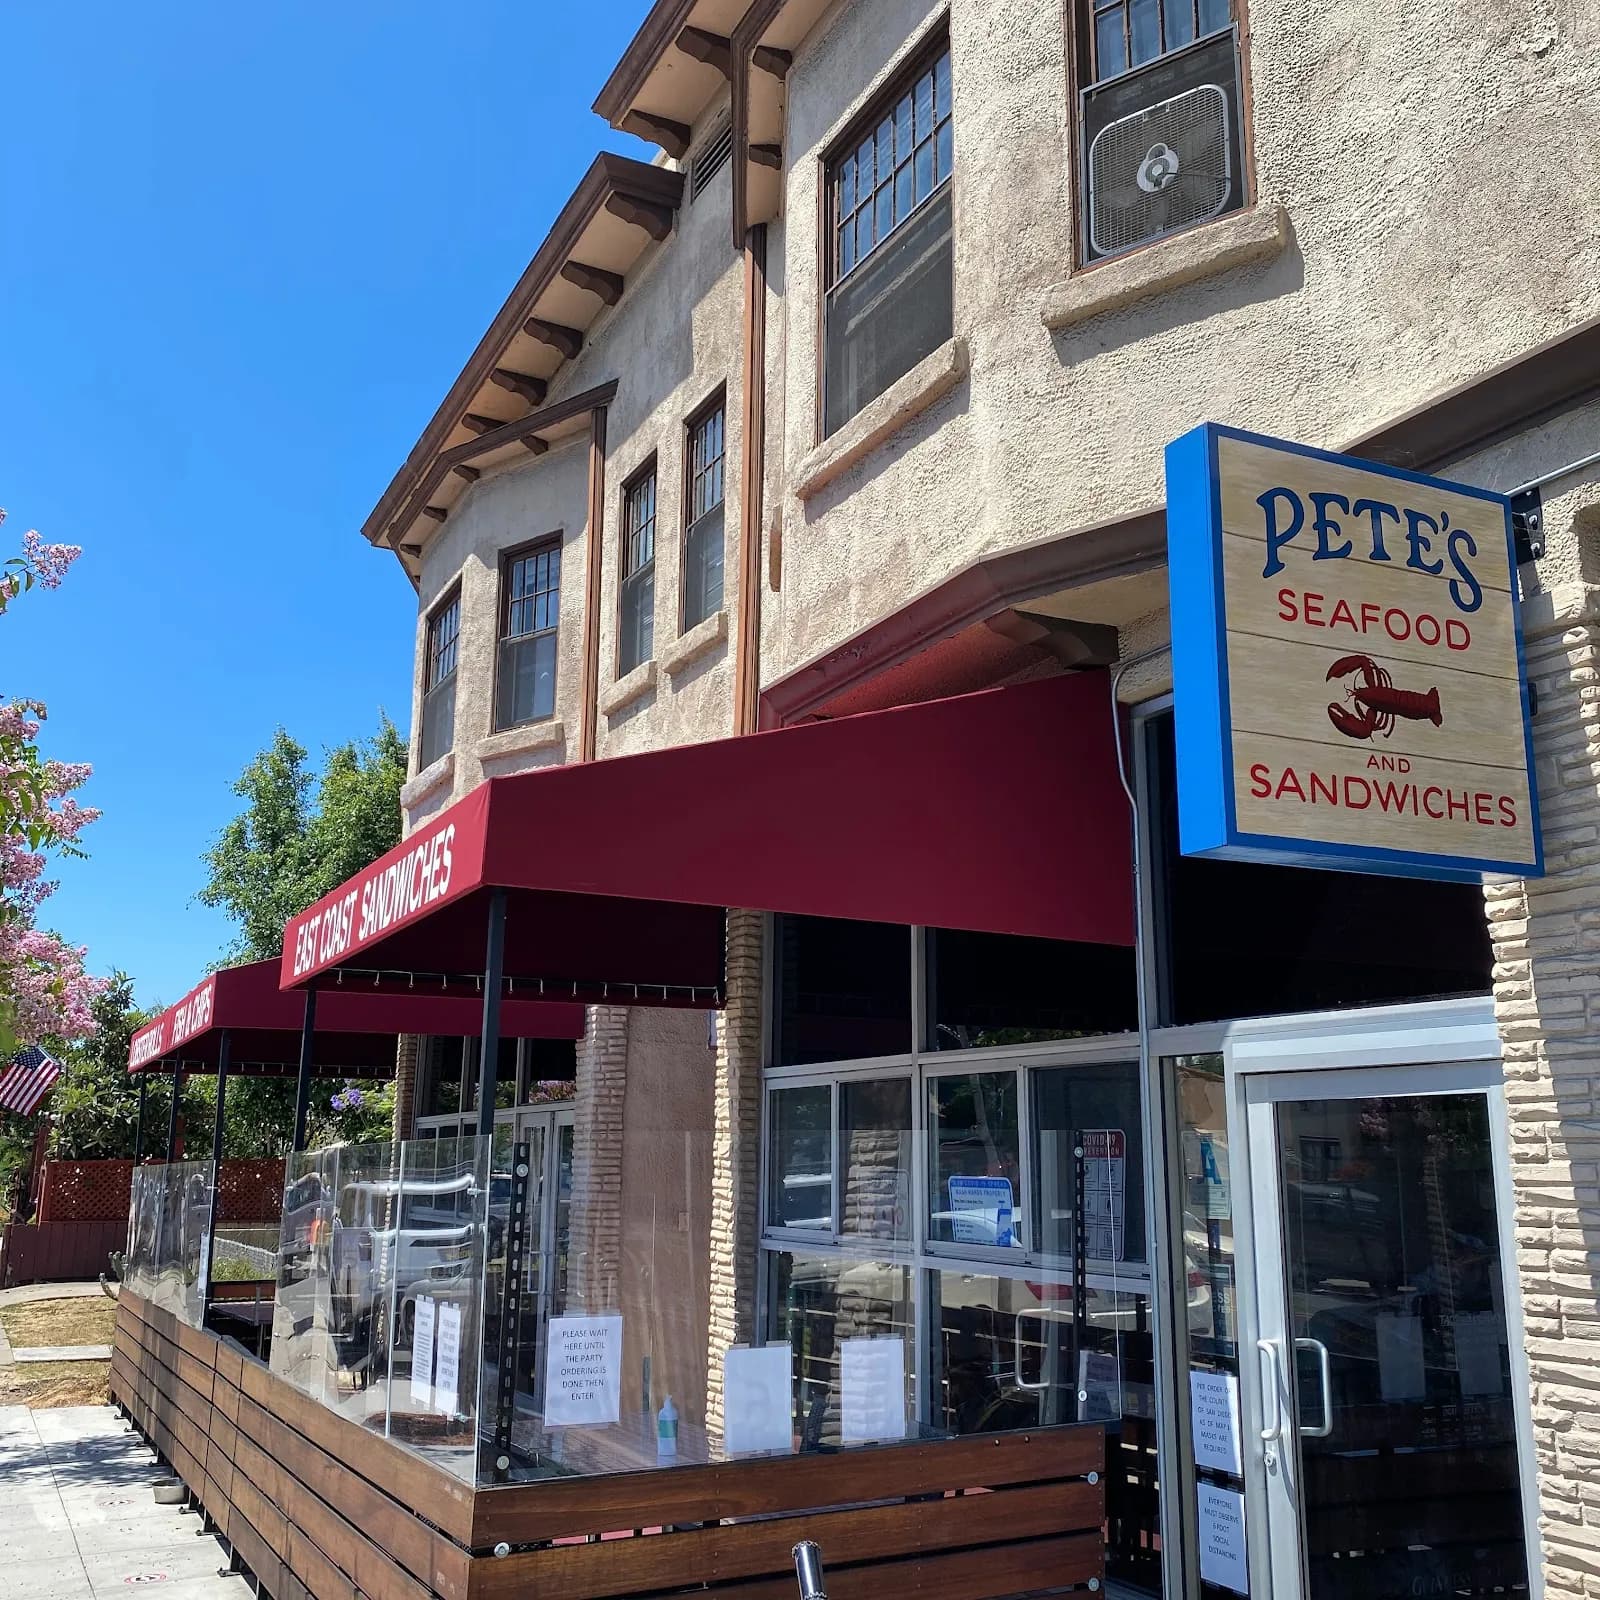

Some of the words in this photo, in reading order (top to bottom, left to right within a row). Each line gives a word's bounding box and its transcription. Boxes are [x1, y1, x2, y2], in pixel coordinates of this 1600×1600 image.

[1256, 487, 1482, 612] PETE'S
[1278, 588, 1471, 651] SEAFOOD
[1366, 754, 1411, 774] AND
[1250, 763, 1517, 828] SANDWICHES
[293, 912, 322, 977] EAST
[319, 889, 358, 963] COAST
[358, 823, 456, 941] SANDWICHES
[191, 984, 212, 1033] CHIPS
[562, 1330, 587, 1338] PLEASE
[589, 1329, 608, 1337] WAIT
[584, 1342, 605, 1350] UNTIL
[565, 1355, 579, 1363] THE
[580, 1354, 603, 1362] PARTY
[560, 1367, 599, 1376] ORDERING
[600, 1366, 607, 1374] IS
[562, 1380, 584, 1388] DONE
[585, 1379, 604, 1387] THEN
[571, 1392, 594, 1401] ENTER
[1201, 1431, 1217, 1440] MASKS
[1204, 1443, 1227, 1454] REQUIRED
[1208, 1497, 1232, 1509] EVERYONE
[1204, 1507, 1219, 1517] MUST
[1213, 1535, 1230, 1546] SOCIAL
[1208, 1546, 1237, 1560] DISTANCING
